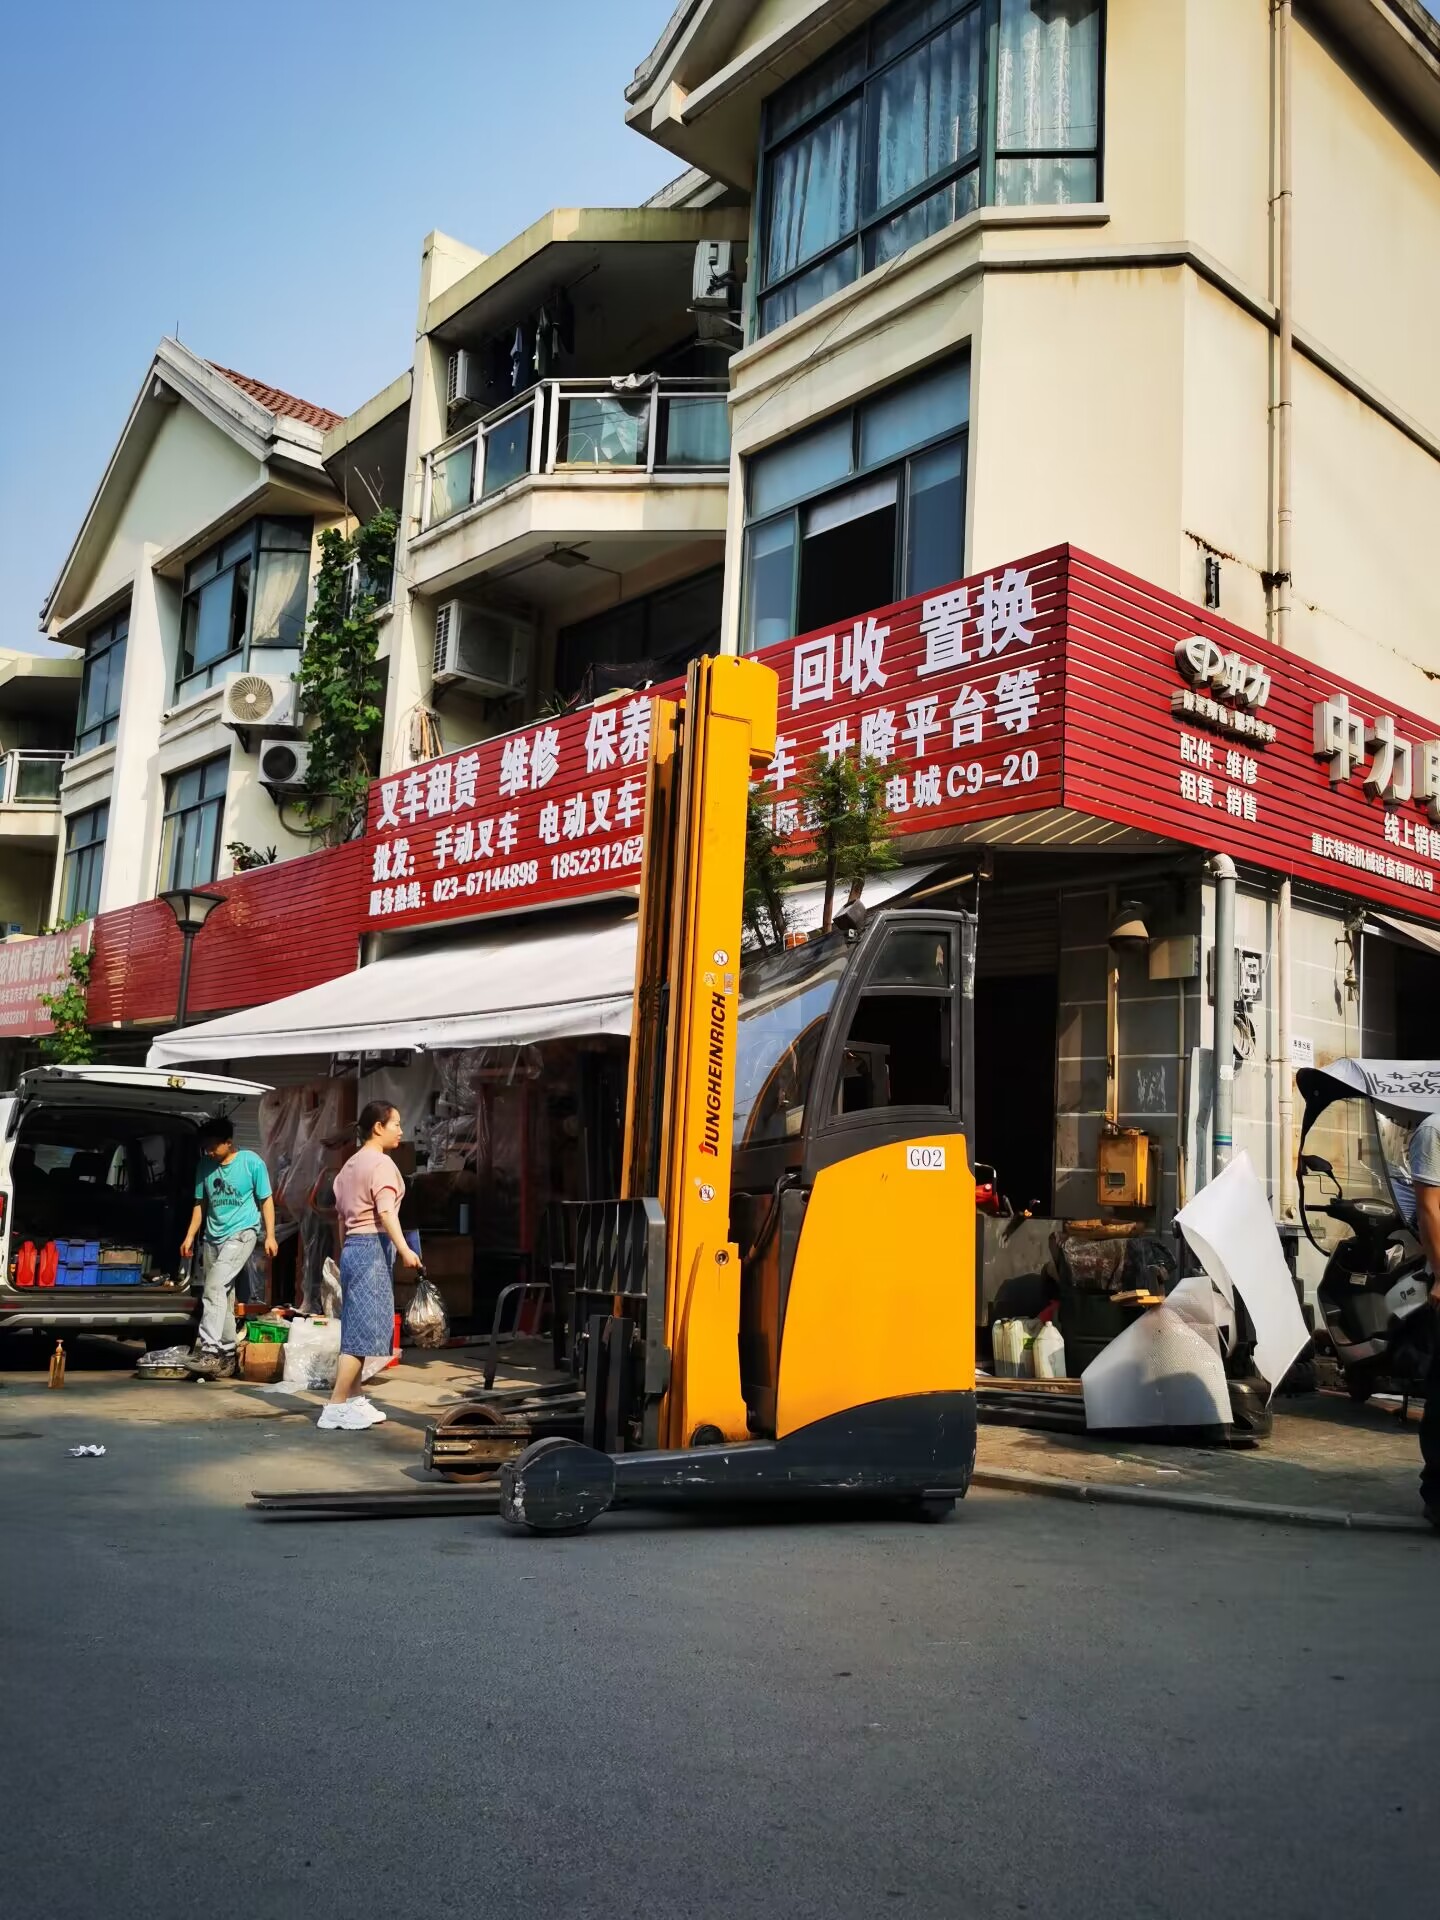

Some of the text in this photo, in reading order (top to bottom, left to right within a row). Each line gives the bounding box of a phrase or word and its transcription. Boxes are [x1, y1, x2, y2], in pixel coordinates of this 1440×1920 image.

[372, 838, 415, 882] 批发：
[433, 811, 519, 869] 手动叉车
[539, 780, 641, 844] 电动叉车
[821, 669, 1041, 770] 升降平台等
[376, 568, 1037, 830] 叉车租赁 维修 保养 回收 置换
[432, 860, 538, 902] 023-67144898
[700, 992, 726, 1157] JUNGHEINRICH
